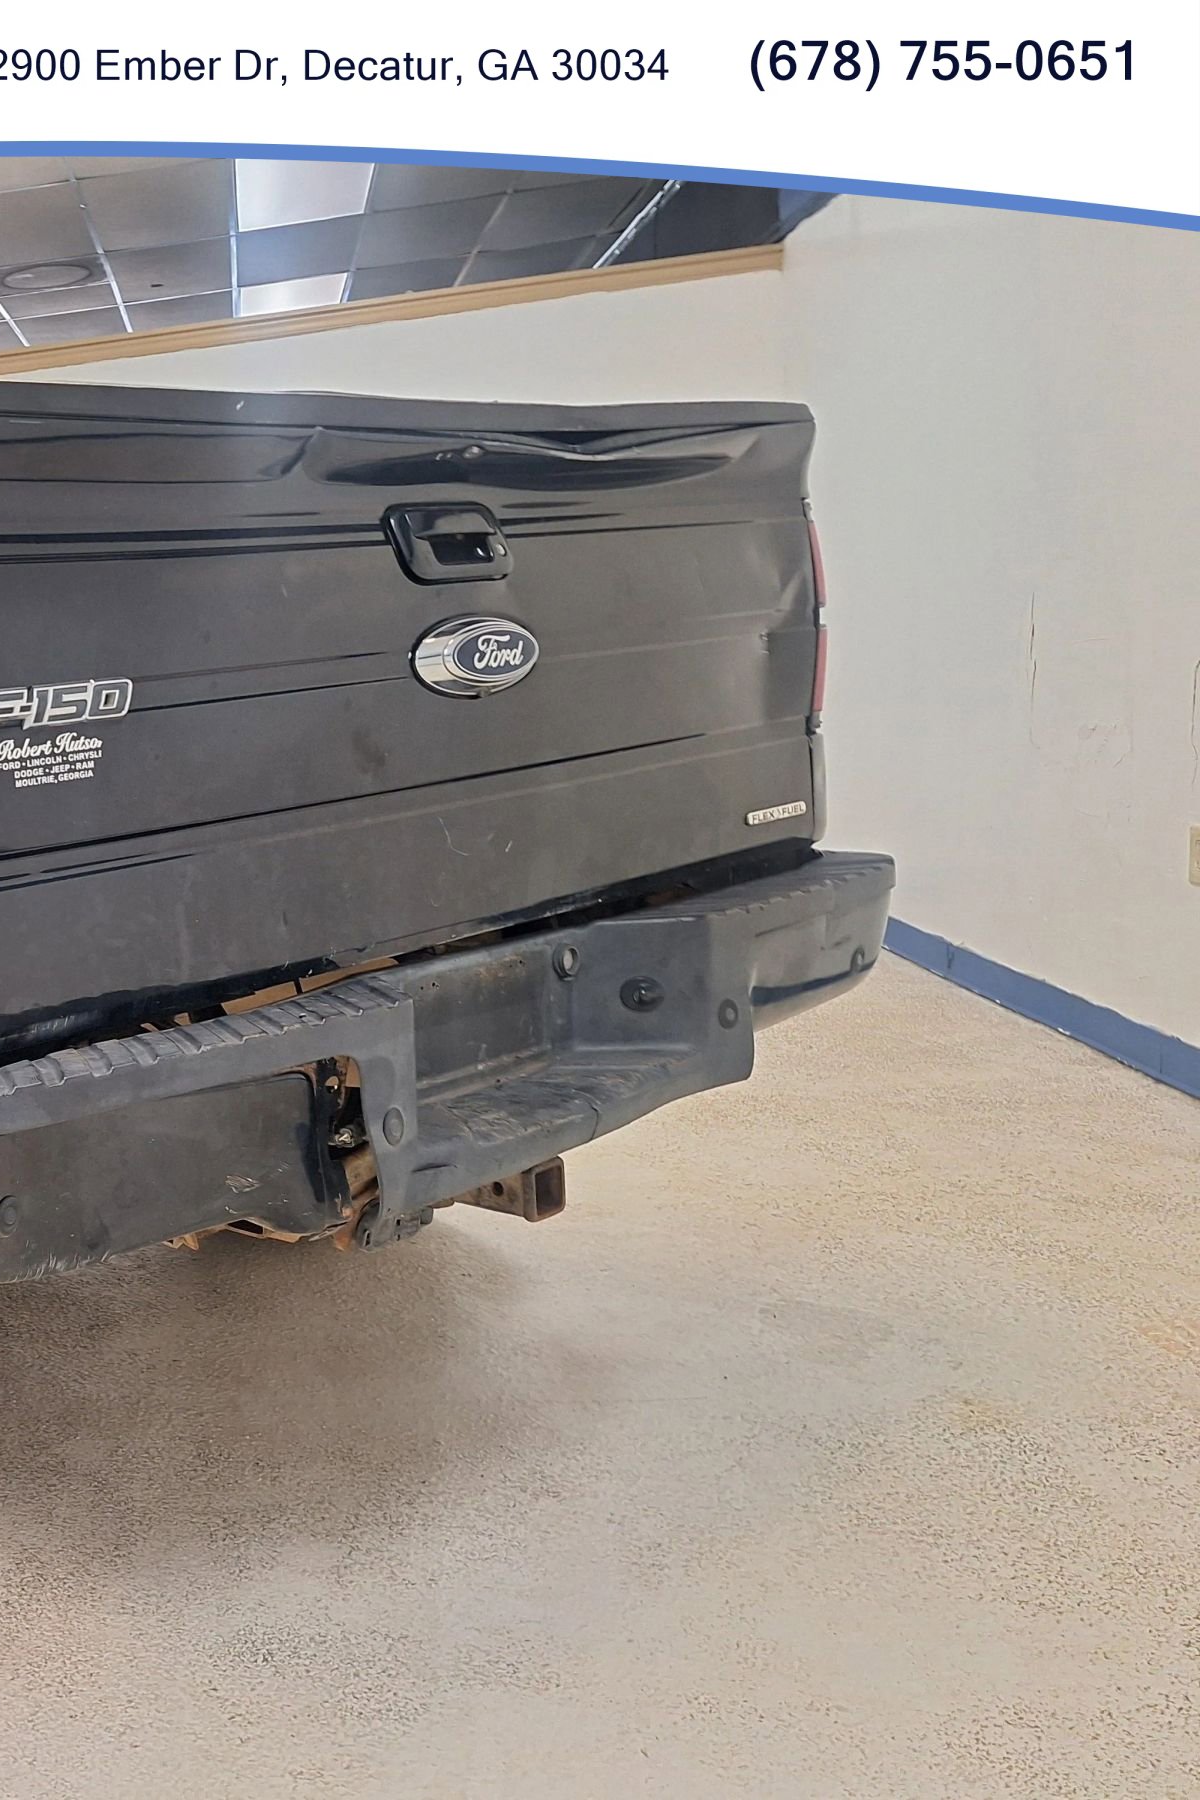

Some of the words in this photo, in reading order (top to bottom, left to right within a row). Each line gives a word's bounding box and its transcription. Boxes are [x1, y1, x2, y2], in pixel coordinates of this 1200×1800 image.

[473, 634, 524, 670] Ford
[14, 767, 44, 779] DODGE
[50, 764, 70, 774] JEEP
[75, 760, 95, 771] RAM
[27, 755, 62, 768] LINCOLN
[15, 775, 58, 788] MOULTRIE,
[58, 769, 94, 782] GEORGIA
[752, 810, 775, 825] FLEX
[781, 803, 804, 816] FUEL
